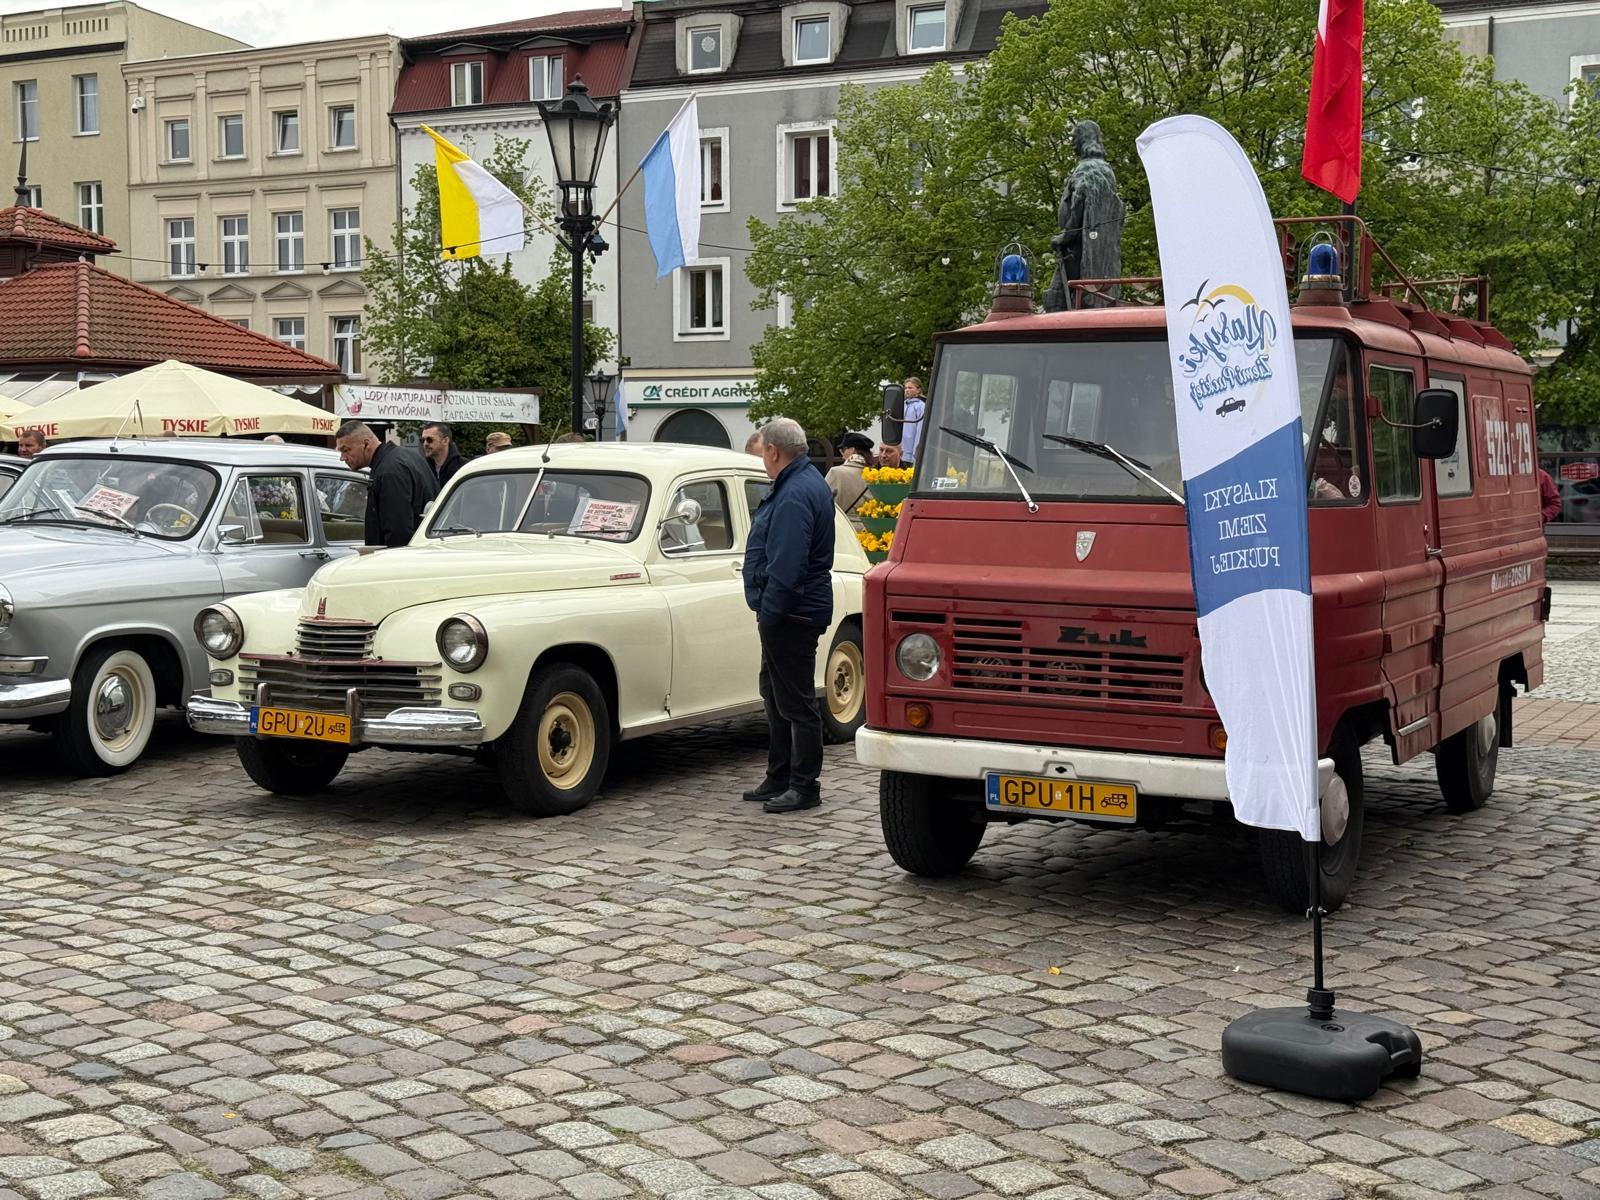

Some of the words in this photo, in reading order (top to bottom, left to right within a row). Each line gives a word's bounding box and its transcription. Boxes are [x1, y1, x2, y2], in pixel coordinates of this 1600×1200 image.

[364, 390, 388, 401] LODY
[391, 392, 442, 404] NATURALNE
[476, 395, 491, 406] TEN
[665, 387, 709, 398] CRÉDIT
[378, 404, 431, 417] WYTWÓRNIA
[444, 409, 494, 421] ZAPRASZAMY
[161, 418, 209, 432] TYSKIE
[233, 417, 260, 432] TYSKIE
[311, 417, 334, 432] TYSKIE
[262, 711, 298, 733] GPU
[304, 715, 325, 737] 2U
[989, 792, 1000, 801] PL
[1004, 779, 1054, 808] GPU
[1064, 784, 1095, 812] 1H
